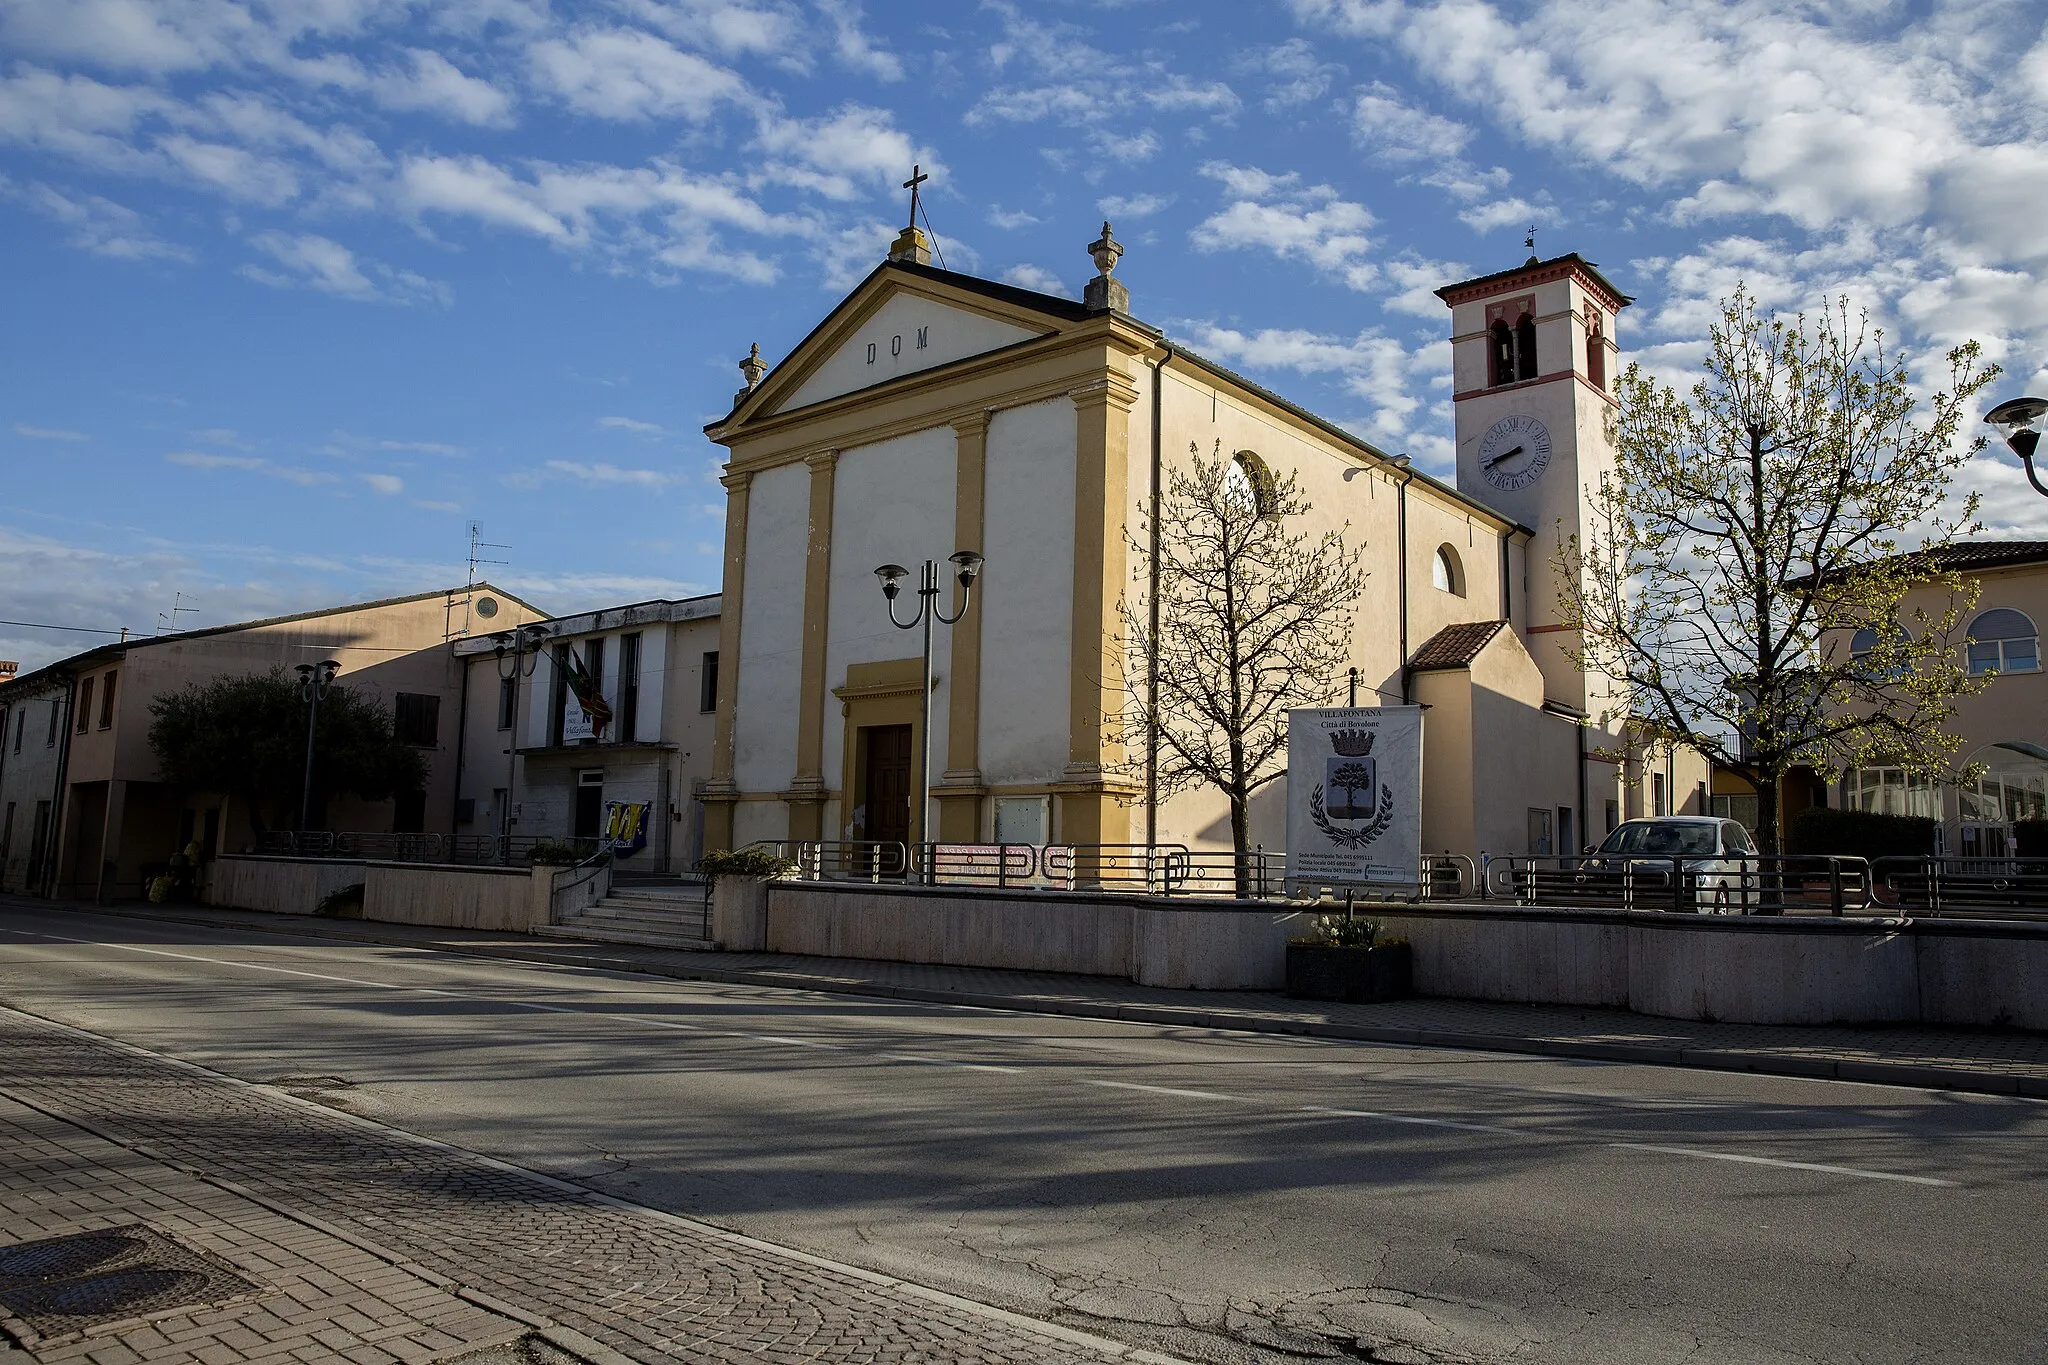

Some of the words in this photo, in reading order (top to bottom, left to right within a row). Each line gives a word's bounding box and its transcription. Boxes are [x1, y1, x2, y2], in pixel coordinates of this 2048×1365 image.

[1319, 710, 1382, 718] VILLAFONTANA
[1321, 720, 1338, 728] Città
[1340, 720, 1346, 728] di
[1348, 720, 1380, 728] Bovolone
